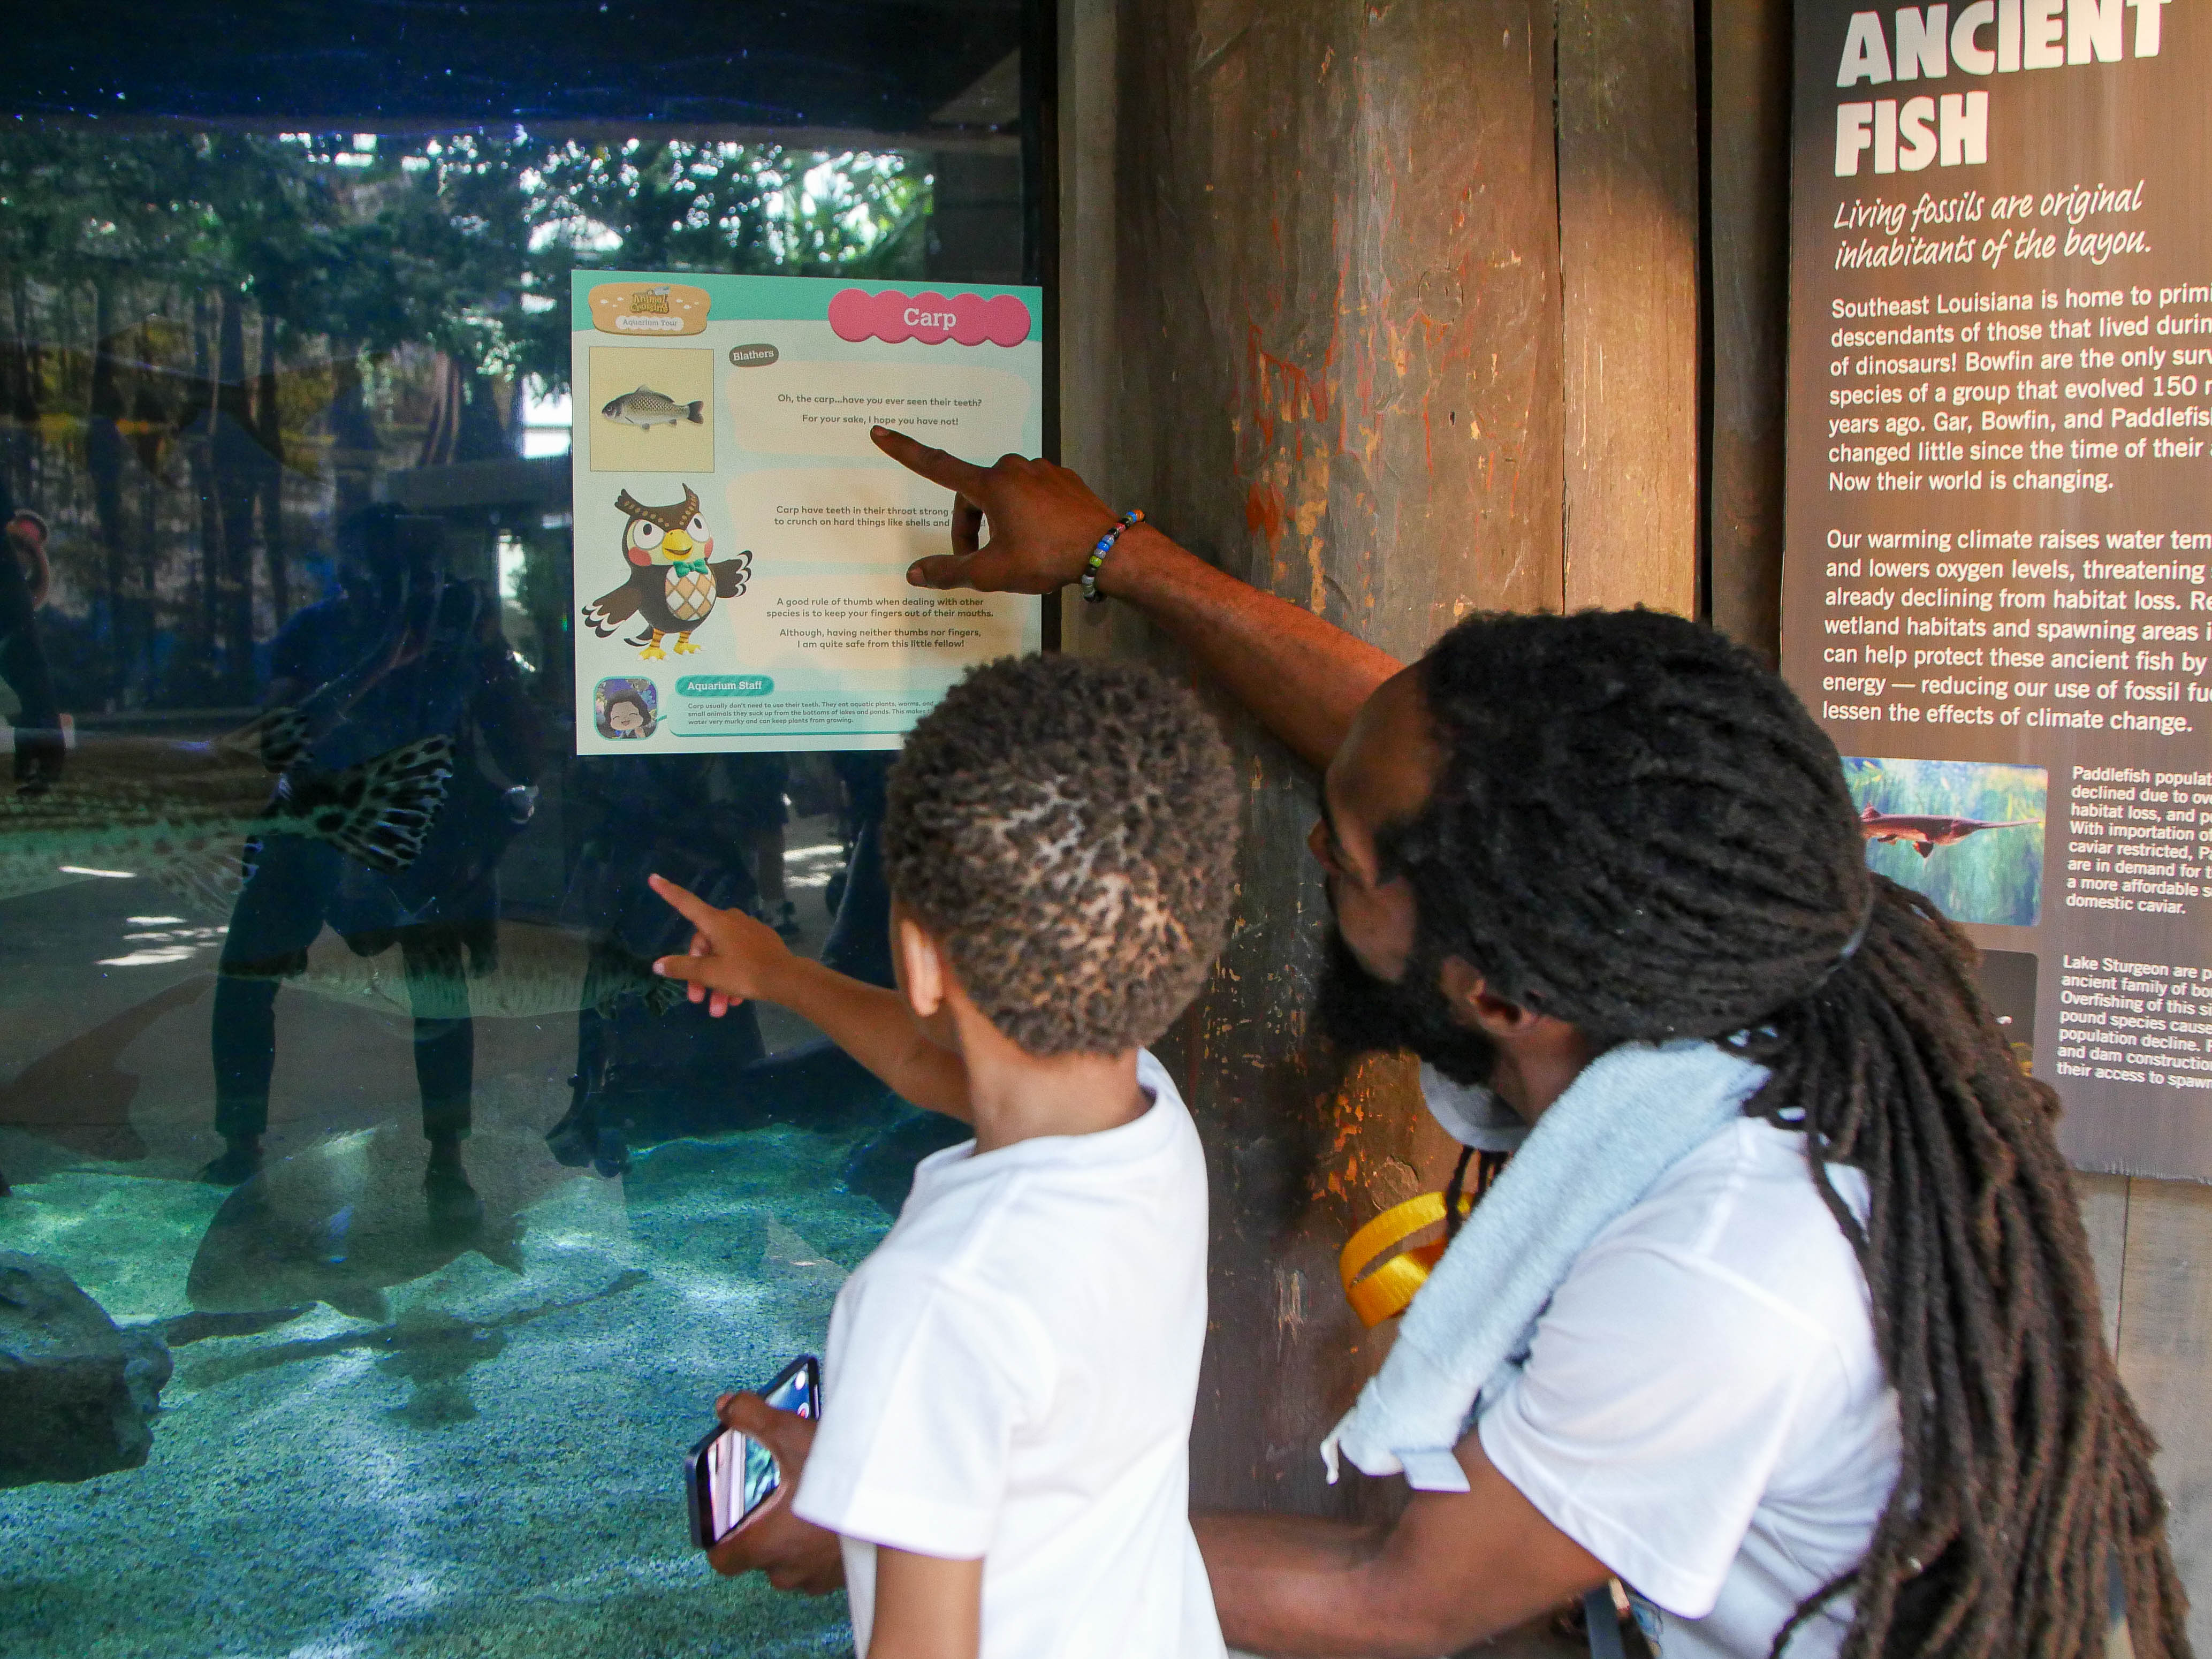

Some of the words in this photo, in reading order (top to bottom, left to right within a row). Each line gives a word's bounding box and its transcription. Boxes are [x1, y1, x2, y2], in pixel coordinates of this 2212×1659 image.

[1836, 0, 2172, 87] ANCIENT
[1835, 90, 1988, 177] FISH
[1834, 198, 1906, 235] Living
[1911, 191, 1985, 232] fossils
[1991, 195, 2033, 219] are
[2040, 180, 2144, 224] original
[1835, 235, 1976, 269] inhabitants
[1982, 229, 2012, 269] of
[2015, 229, 2056, 259] the
[2064, 227, 2150, 265] bayou.
[1833, 296, 1929, 318] Southeast
[1938, 292, 2033, 313] Louisiana
[2042, 290, 2058, 309] is
[2066, 288, 2123, 308] home
[2131, 286, 2152, 305] to
[904, 308, 956, 330] Carp
[1831, 324, 1954, 347] descendants
[1961, 322, 1980, 342] of
[1987, 322, 2042, 341] those
[2049, 319, 2091, 339] that
[2100, 316, 2148, 337] lived
[733, 351, 774, 361] Blathers
[1831, 356, 1849, 376] of
[1856, 353, 1956, 375] dinosaurs!
[1966, 351, 2032, 371] Bowfin
[2041, 353, 2072, 369] are
[2080, 348, 2114, 368] the
[2122, 346, 2165, 370] only
[778, 394, 793, 403] Oh,
[797, 394, 811, 402] the
[815, 396, 864, 405] carp...have
[1830, 384, 1902, 408] species
[1909, 383, 1928, 402] of
[1935, 387, 1945, 401] a
[1953, 385, 2010, 406] group
[2017, 380, 2058, 400] that
[2065, 377, 2143, 398] evolved
[2154, 376, 2196, 396] 150
[843, 416, 865, 424] sake,
[873, 416, 895, 426] hope
[1829, 418, 1879, 437] years
[1886, 417, 1925, 436] ago.
[1934, 412, 1972, 433] Gar,
[1982, 410, 2055, 432] Bowfin,
[2064, 408, 2102, 429] and
[1830, 473, 1871, 491] Now
[1877, 471, 1922, 490] their
[1929, 470, 1981, 490] world
[1990, 470, 2006, 489] is
[2013, 469, 2113, 493] changing.
[777, 506, 799, 515] Carp
[919, 508, 948, 517] strong
[1828, 529, 1861, 548] Our
[1868, 529, 1951, 552] warming
[1958, 529, 2032, 549] climate
[2040, 529, 2099, 549] raises
[2106, 530, 2164, 549] water
[2171, 530, 2211, 549] tem
[1827, 559, 1861, 577] and
[1870, 559, 1929, 577] lowers
[1937, 563, 2003, 582] oxygen
[2012, 559, 2074, 581] levels,
[2083, 560, 2205, 584] threatening
[786, 598, 809, 607] good
[902, 598, 934, 607] dealing
[820, 640, 843, 649] quite
[688, 682, 736, 691] Aquarium
[739, 681, 762, 689] Staff
[1823, 701, 1881, 720] lessen
[1889, 703, 1920, 722] the
[1927, 704, 1994, 725] effects
[2000, 707, 2020, 725] of
[2027, 708, 2103, 728] climate
[2110, 711, 2192, 735] change.
[2073, 766, 2150, 782] Paddlefish
[2071, 785, 2135, 800] declined
[2140, 788, 2168, 802] due
[2172, 790, 2188, 803] to
[2070, 820, 2103, 835] With
[2109, 823, 2194, 840] importation
[2068, 860, 2091, 871] are
[2096, 858, 2110, 872] in
[2115, 860, 2175, 876] demand
[2180, 864, 2201, 878] for
[2066, 893, 2133, 910] domestic
[2138, 900, 2185, 914] caviar.
[2063, 955, 2098, 970] Lake
[2102, 958, 2169, 977] Sturgeon
[2173, 967, 2198, 978] are
[2062, 975, 2117, 990] ancient
[2121, 978, 2168, 998] family
[2171, 983, 2187, 995] of
[2061, 991, 2143, 1013] Overfishing
[2147, 999, 2163, 1011] of
[2167, 1000, 2195, 1015] this
[2056, 1062, 2092, 1076] their
[2095, 1068, 2145, 1082] access
[2149, 1071, 2164, 1084] to
